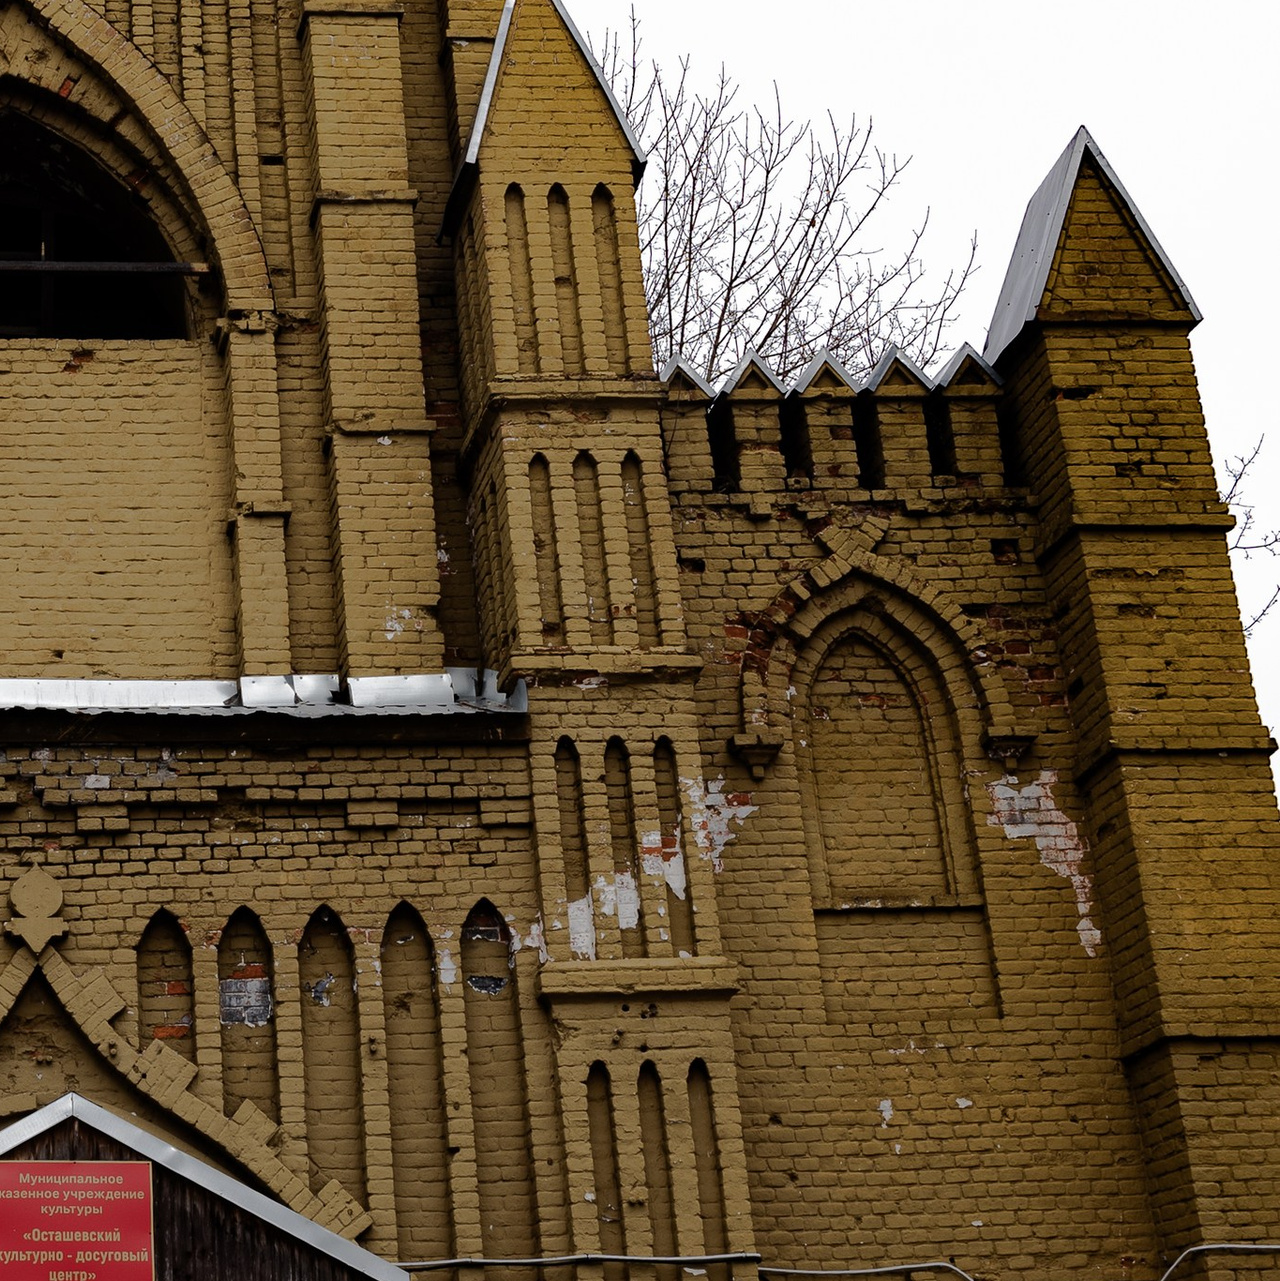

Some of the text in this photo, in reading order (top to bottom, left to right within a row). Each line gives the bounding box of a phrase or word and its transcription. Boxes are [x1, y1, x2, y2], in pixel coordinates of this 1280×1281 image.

[19, 1172, 123, 1186] Муниципальное
[62, 1188, 145, 1202] учреждение
[40, 1205, 103, 1217] культуры
[22, 1227, 121, 1243] «Осташевский
[75, 1247, 149, 1265] досуговый
